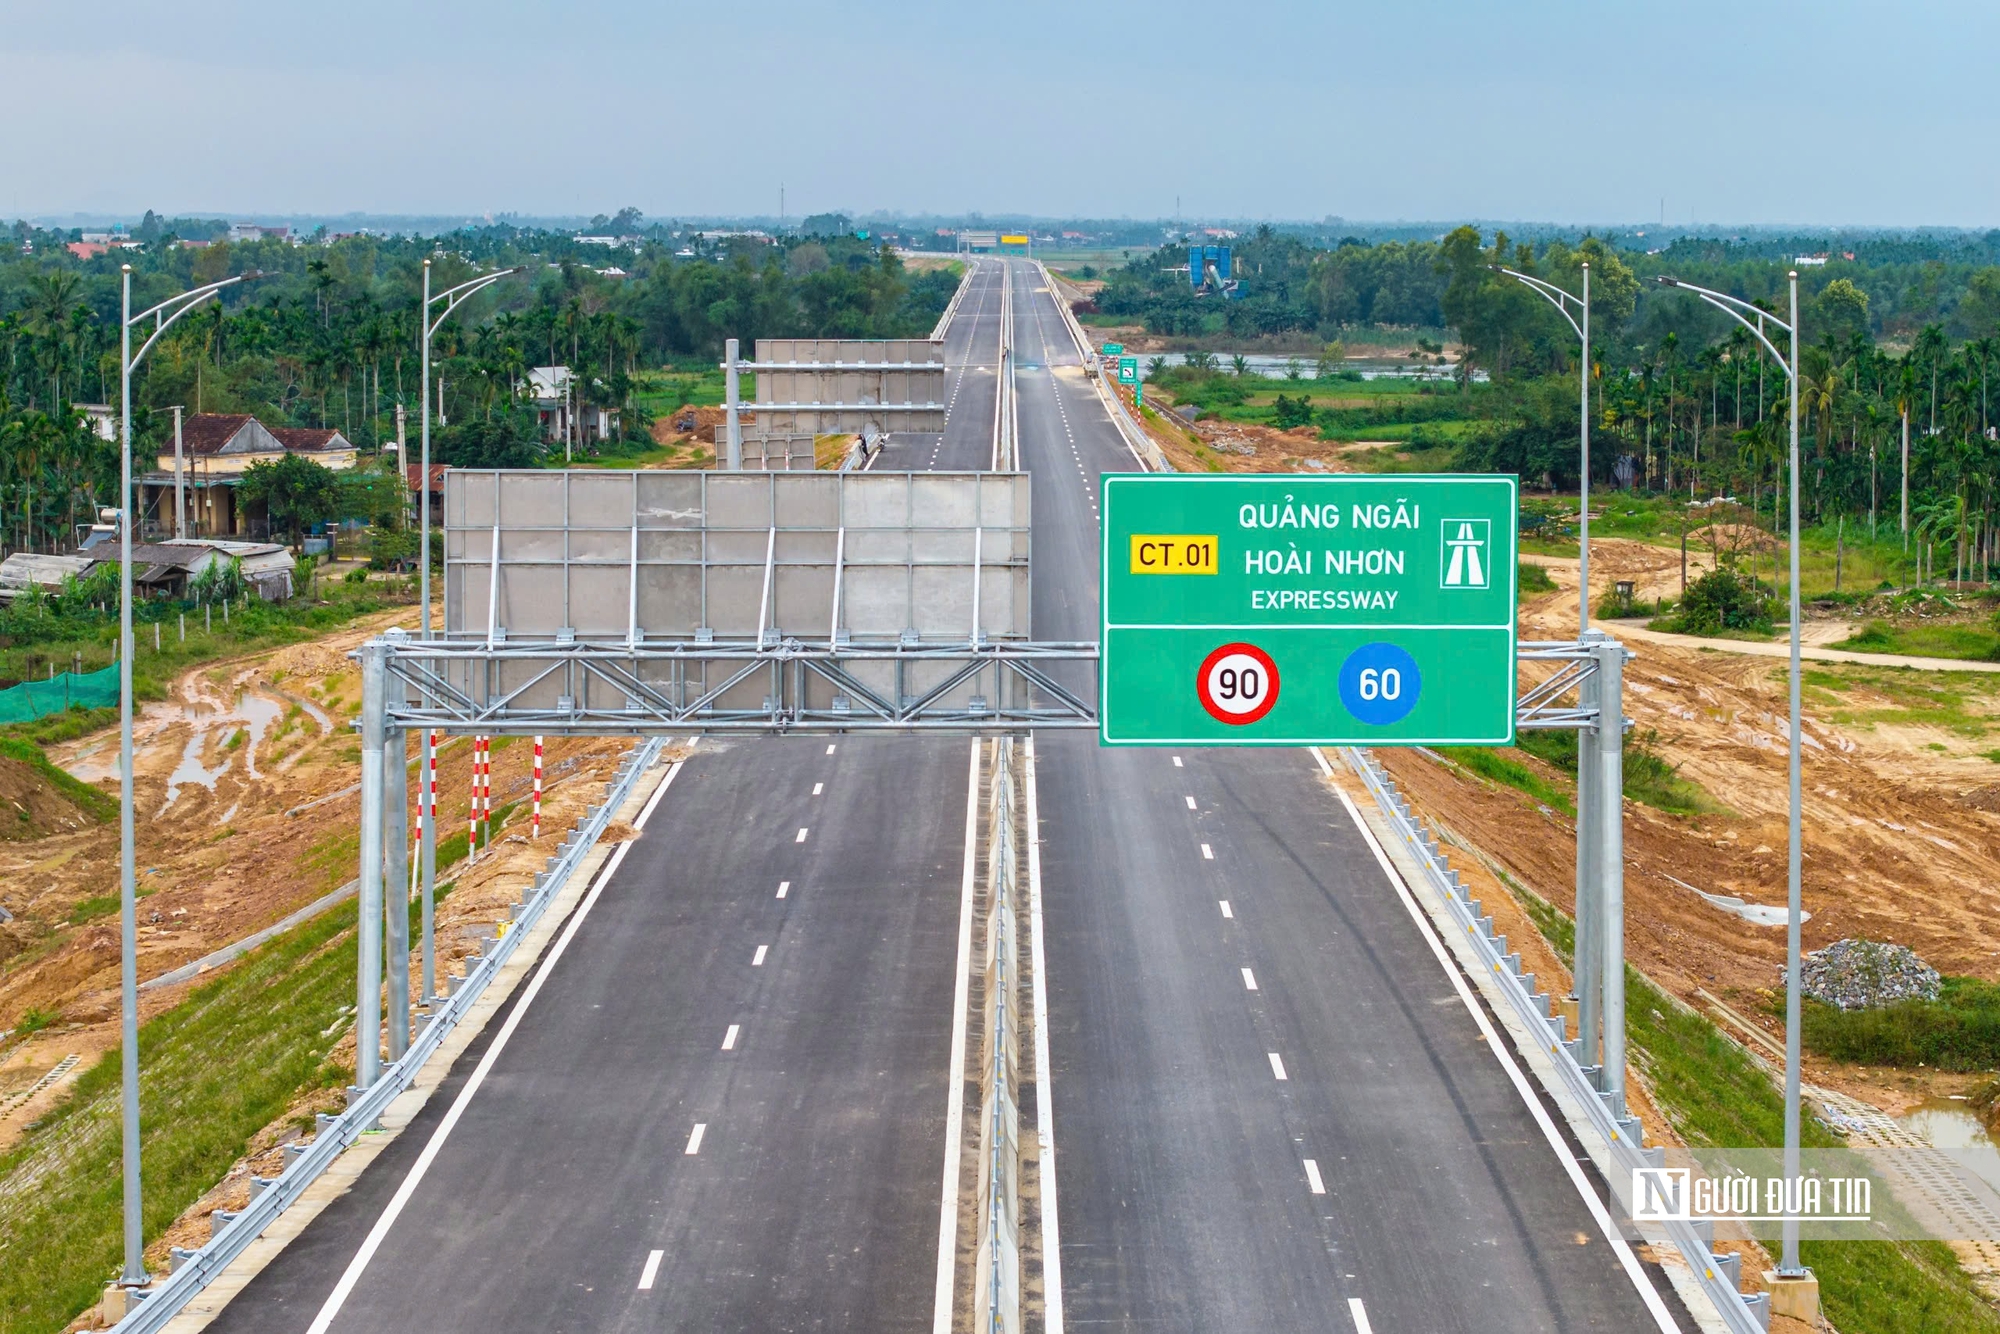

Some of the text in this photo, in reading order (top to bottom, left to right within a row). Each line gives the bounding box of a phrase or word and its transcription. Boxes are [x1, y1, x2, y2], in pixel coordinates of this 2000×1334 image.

[1239, 494, 1420, 529] QUẢNG NGÃI
[1139, 542, 1210, 567] CT.01
[1245, 542, 1405, 575] HOÀI NHƠN
[1251, 590, 1399, 609] EXPRESSWAY
[1218, 667, 1260, 700] 90
[1358, 667, 1401, 701] 60
